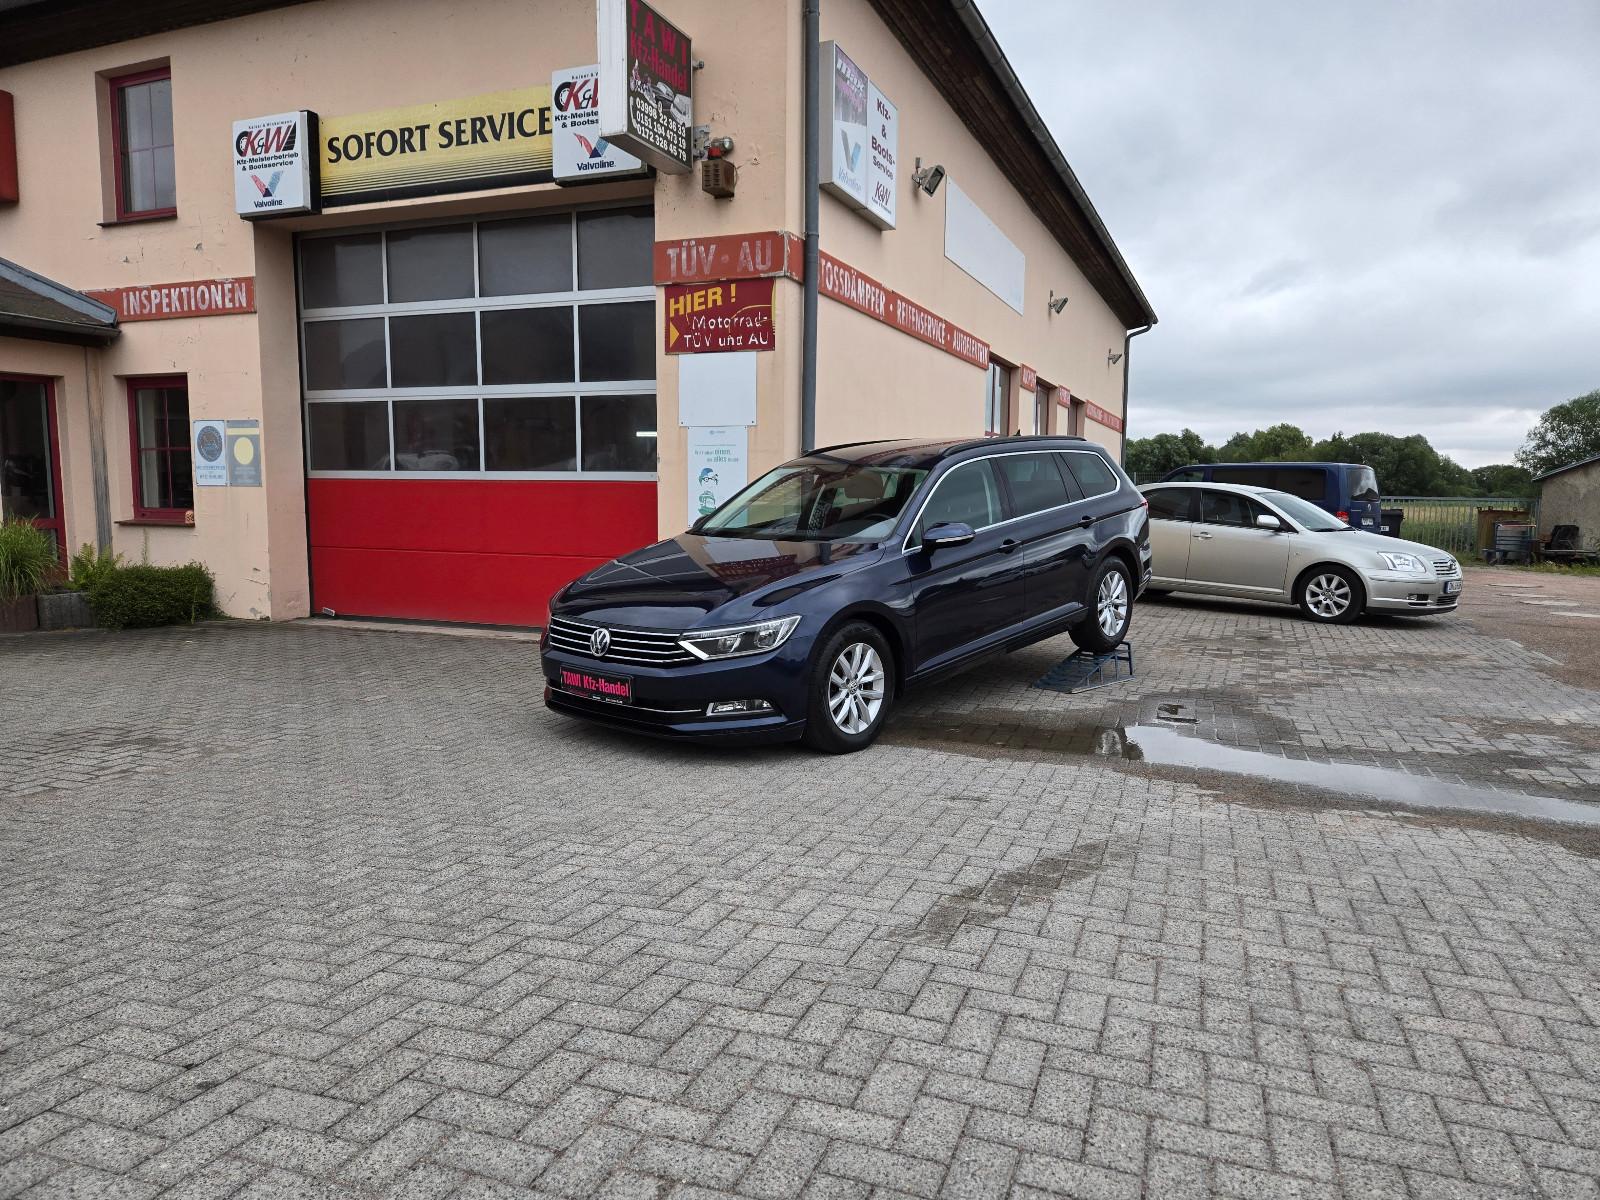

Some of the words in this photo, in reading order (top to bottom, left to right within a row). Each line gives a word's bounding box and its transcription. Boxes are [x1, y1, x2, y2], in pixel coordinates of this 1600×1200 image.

[555, 110, 598, 121] Kfz-Meiste
[636, 97, 657, 119] 03998
[660, 113, 667, 126] 22
[678, 125, 686, 137] 33
[876, 97, 891, 120] Kfz-
[327, 124, 430, 163] SOFORT
[438, 106, 552, 149] SERVICE
[571, 119, 598, 127] Bootss
[637, 111, 652, 130] 0151
[679, 137, 686, 149] 19
[637, 124, 654, 142] 0172
[881, 124, 887, 139] &
[237, 152, 298, 166] Kfz-Meisterbetrieb
[871, 136, 895, 165] Boots-
[249, 160, 293, 170] Bootsservice
[577, 160, 615, 171] Valvoline
[254, 199, 283, 208] Valvoline
[667, 240, 716, 278] TÜV
[737, 240, 771, 272] AU
[819, 258, 886, 317] TOSSDÄMPFER
[123, 283, 247, 316] INSPEKTIONEN
[669, 286, 723, 318] HIER
[684, 332, 712, 348] TÜV
[749, 332, 769, 345] AU
[562, 671, 581, 687] TAWI
[583, 675, 629, 697] Kfz-Handel
